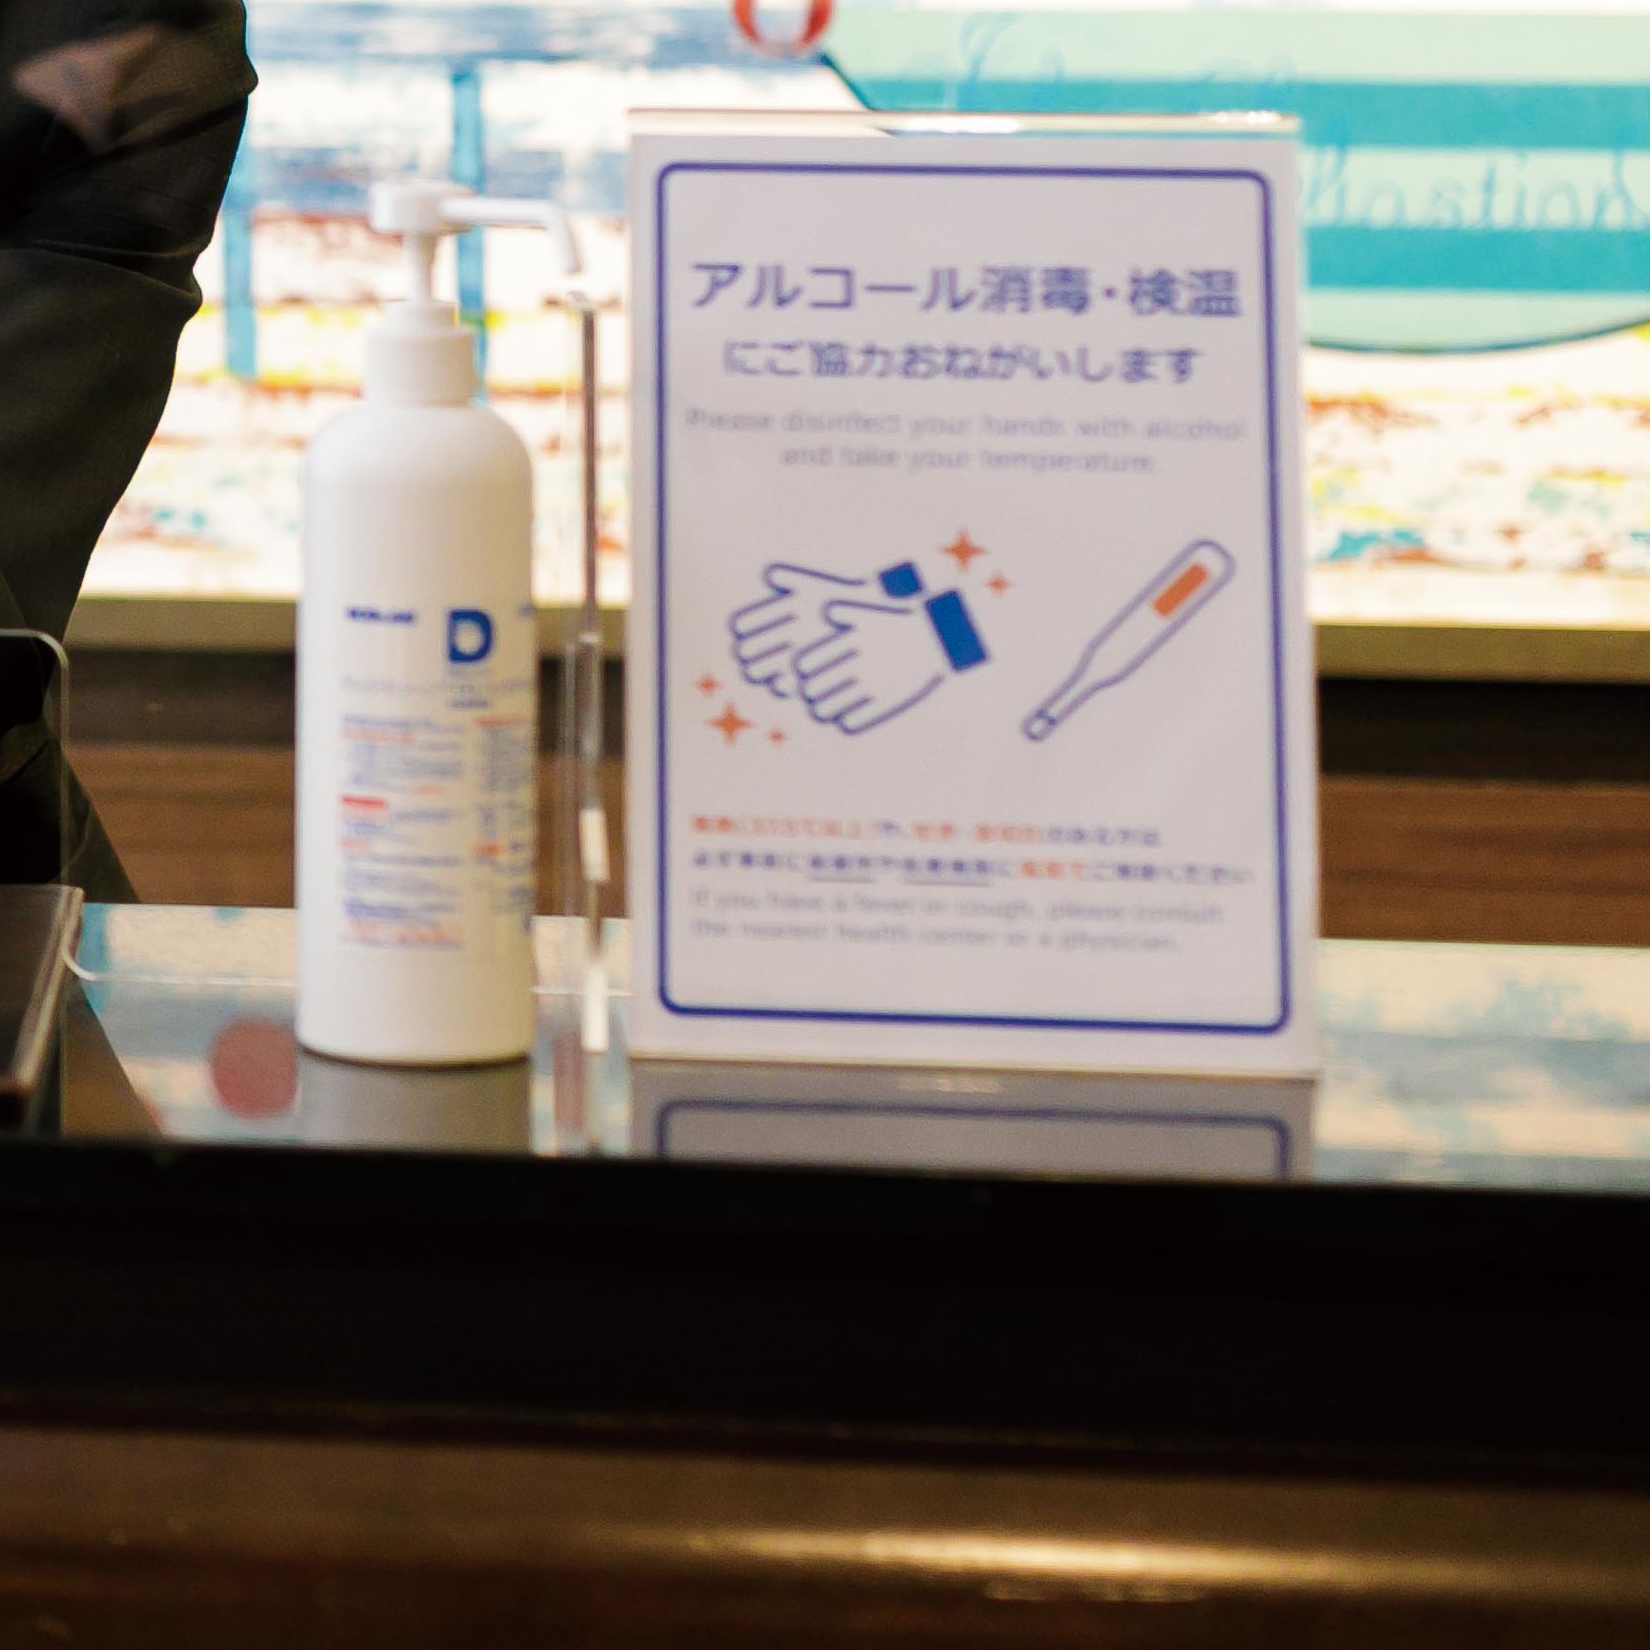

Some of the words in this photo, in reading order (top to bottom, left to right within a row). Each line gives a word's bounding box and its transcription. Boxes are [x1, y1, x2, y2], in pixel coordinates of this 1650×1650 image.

[689, 261, 1243, 319] アルコール消毒・検温
[723, 341, 1204, 385] にご協力おねがいします
[686, 408, 773, 430] Please
[781, 410, 900, 432] disinfect
[909, 418, 970, 439] your
[981, 415, 1066, 436] hands
[1075, 417, 1132, 438] with
[1143, 417, 1247, 441] alcohol
[781, 446, 831, 465] and
[909, 452, 970, 474] your
[449, 608, 494, 663] D
